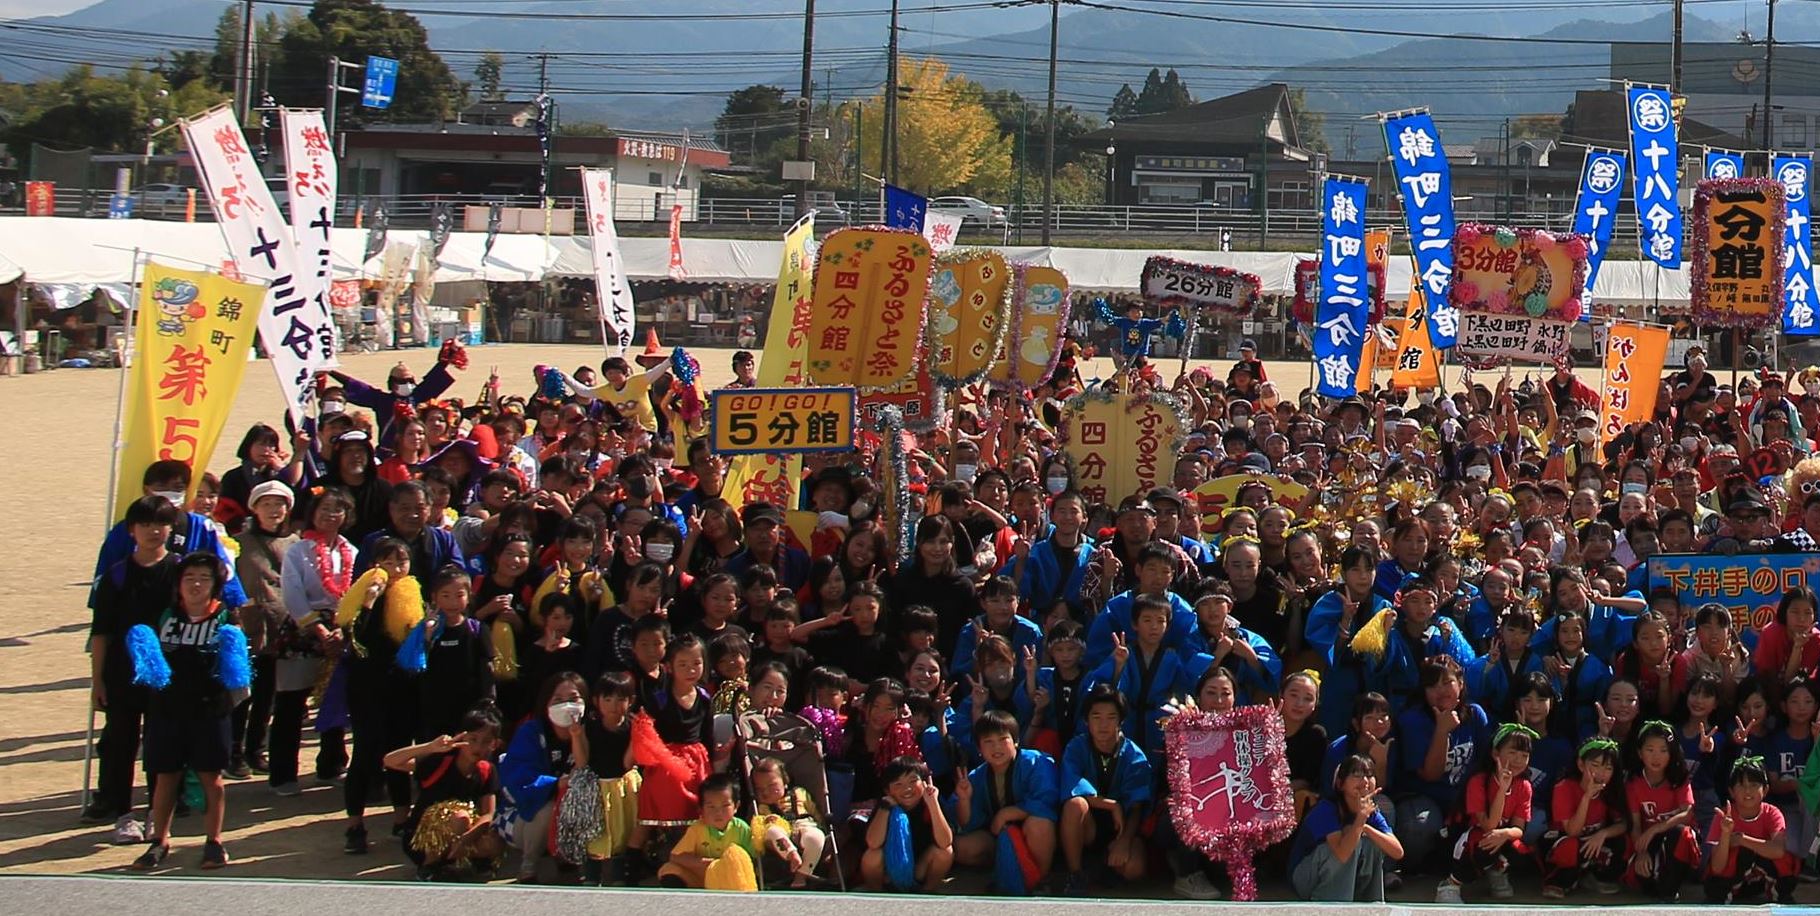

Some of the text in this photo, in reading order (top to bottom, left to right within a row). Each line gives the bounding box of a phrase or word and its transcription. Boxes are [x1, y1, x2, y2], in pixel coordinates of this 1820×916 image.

[1642, 139, 1675, 261] 十八分館
[1164, 273, 1234, 299] 26分館
[1460, 245, 1518, 273] 3分館
[210, 296, 243, 355] 錦町
[819, 271, 861, 351] 四分館
[867, 246, 916, 377] ふるさと祭
[728, 410, 840, 446] 5分館
[1079, 422, 1106, 504] 四分館
[1662, 566, 1808, 597] 下井手の口
